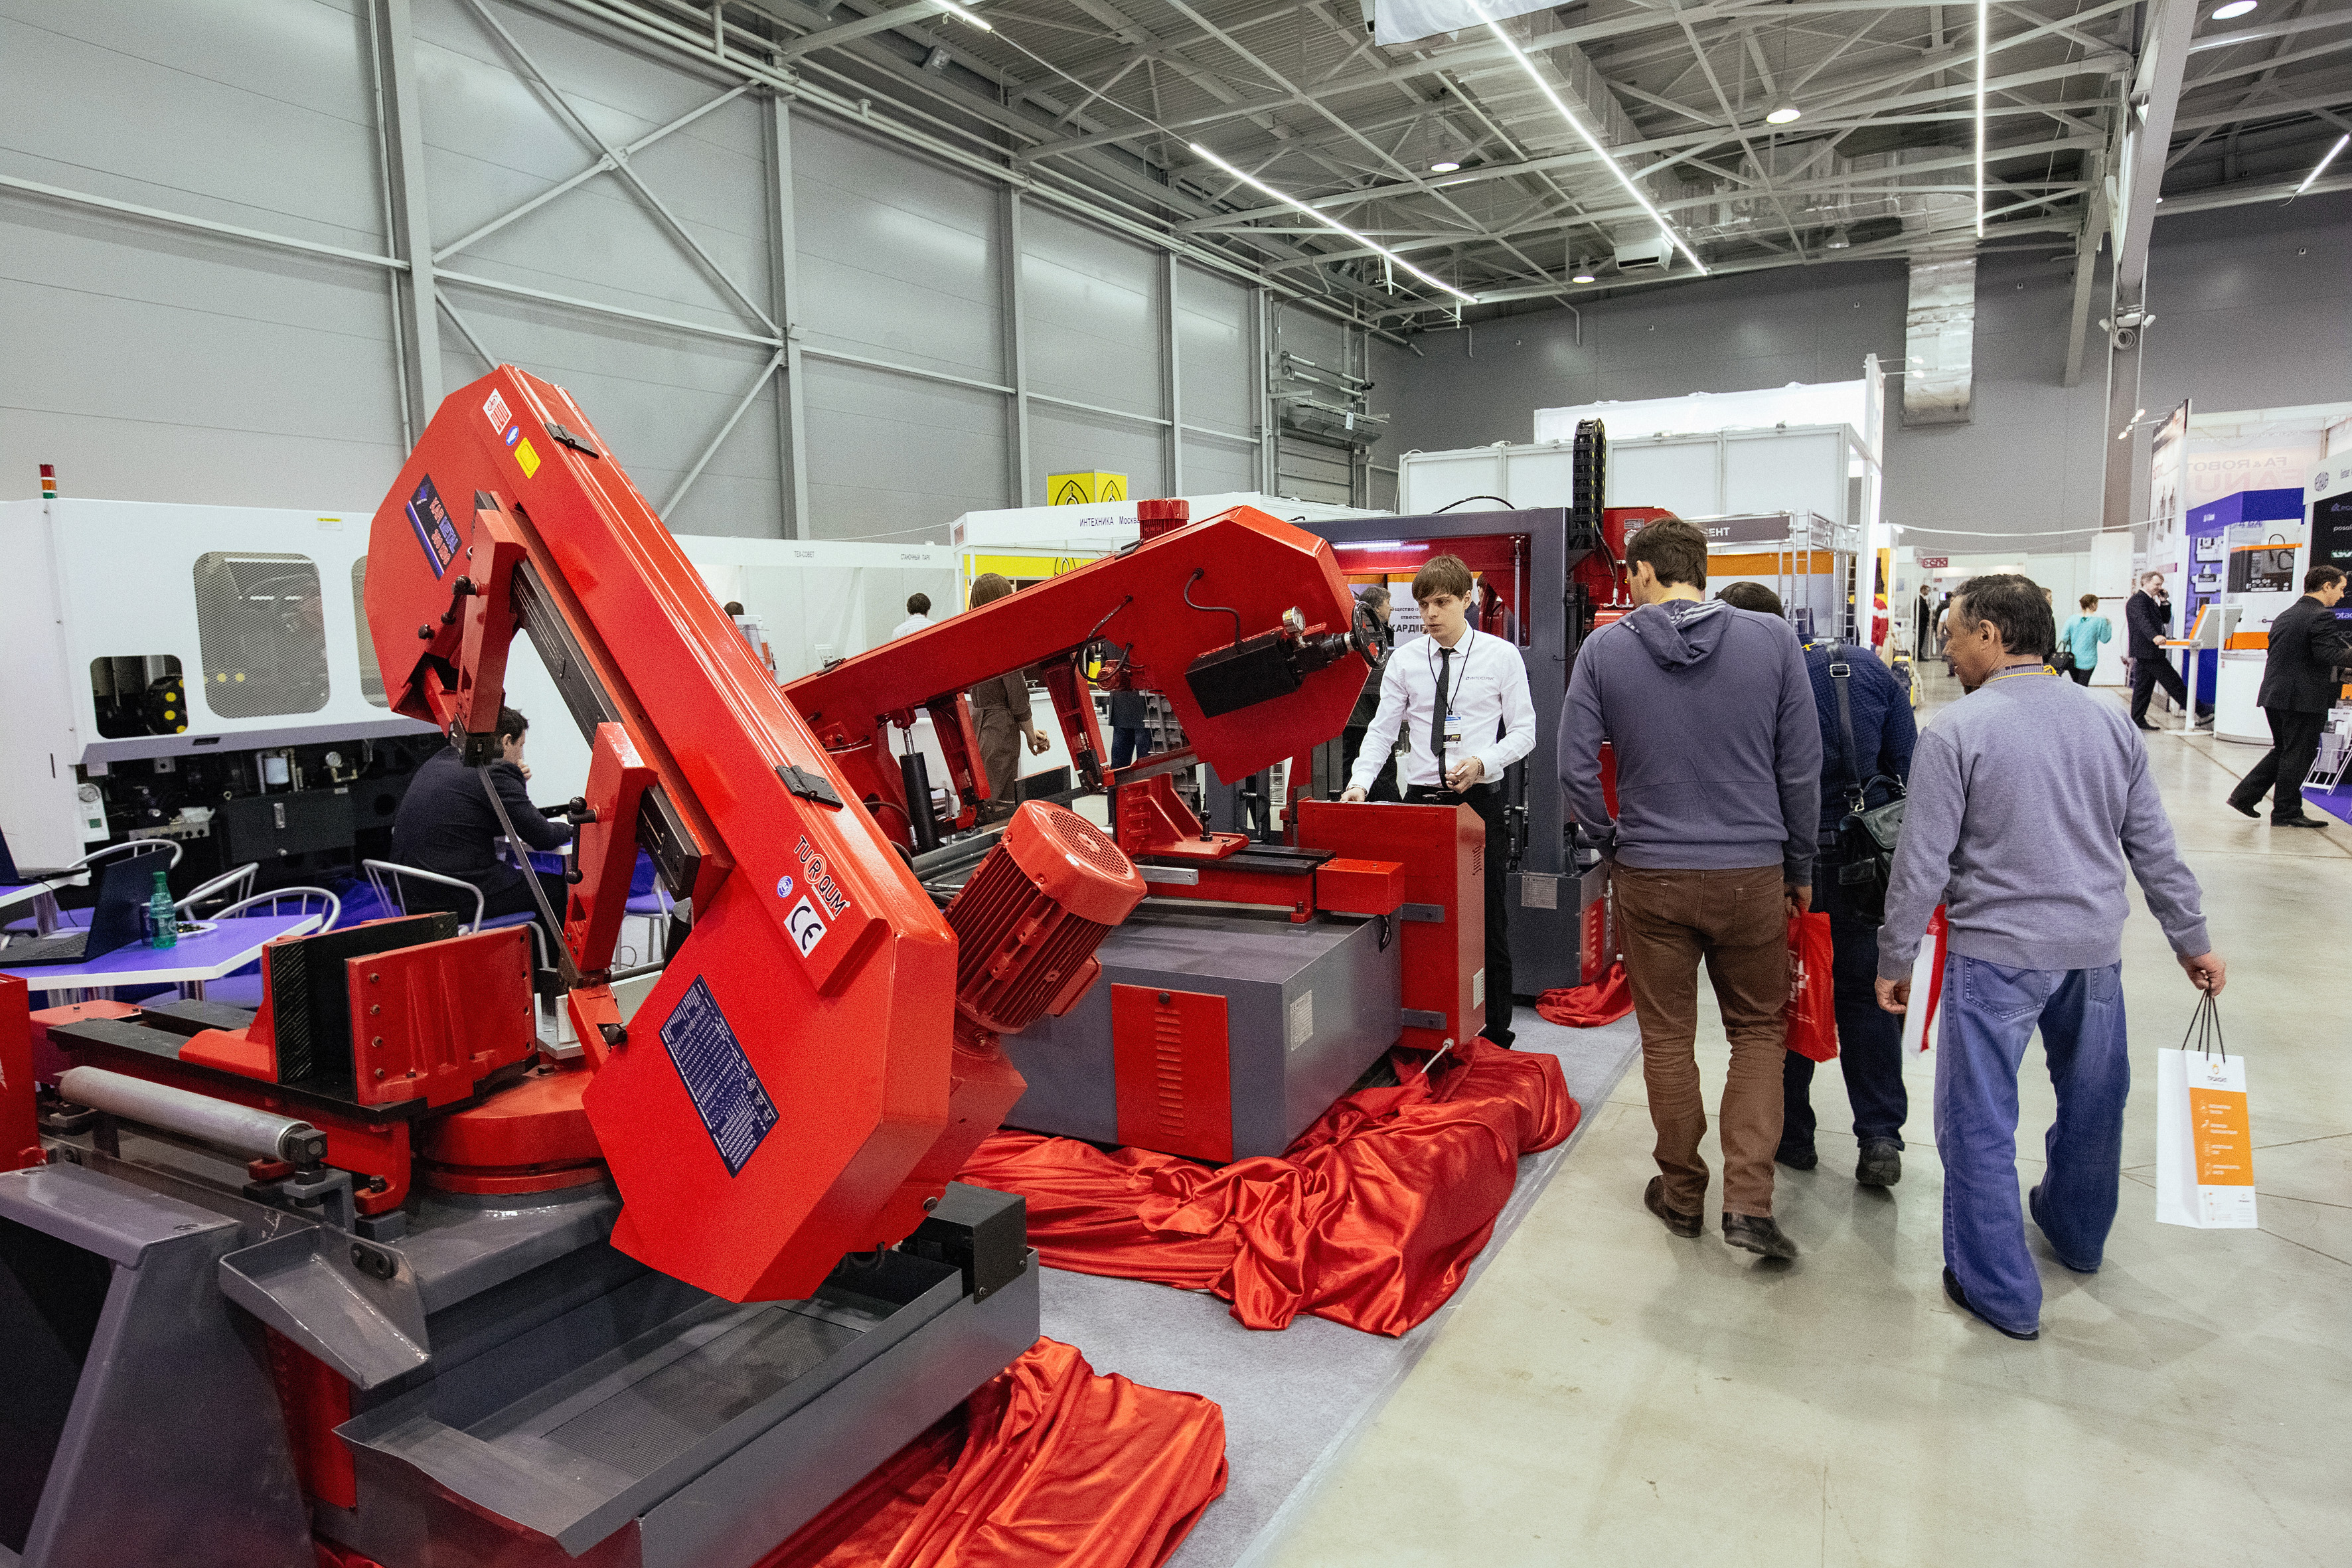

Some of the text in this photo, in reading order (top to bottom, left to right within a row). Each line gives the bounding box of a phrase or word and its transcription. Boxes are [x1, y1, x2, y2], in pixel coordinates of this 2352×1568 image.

[1079, 516, 1114, 527] ИНТЕХНИКА
[1706, 527, 1731, 537] ЕНТ
[794, 834, 847, 917] TURQUM
[791, 905, 823, 951] CE
